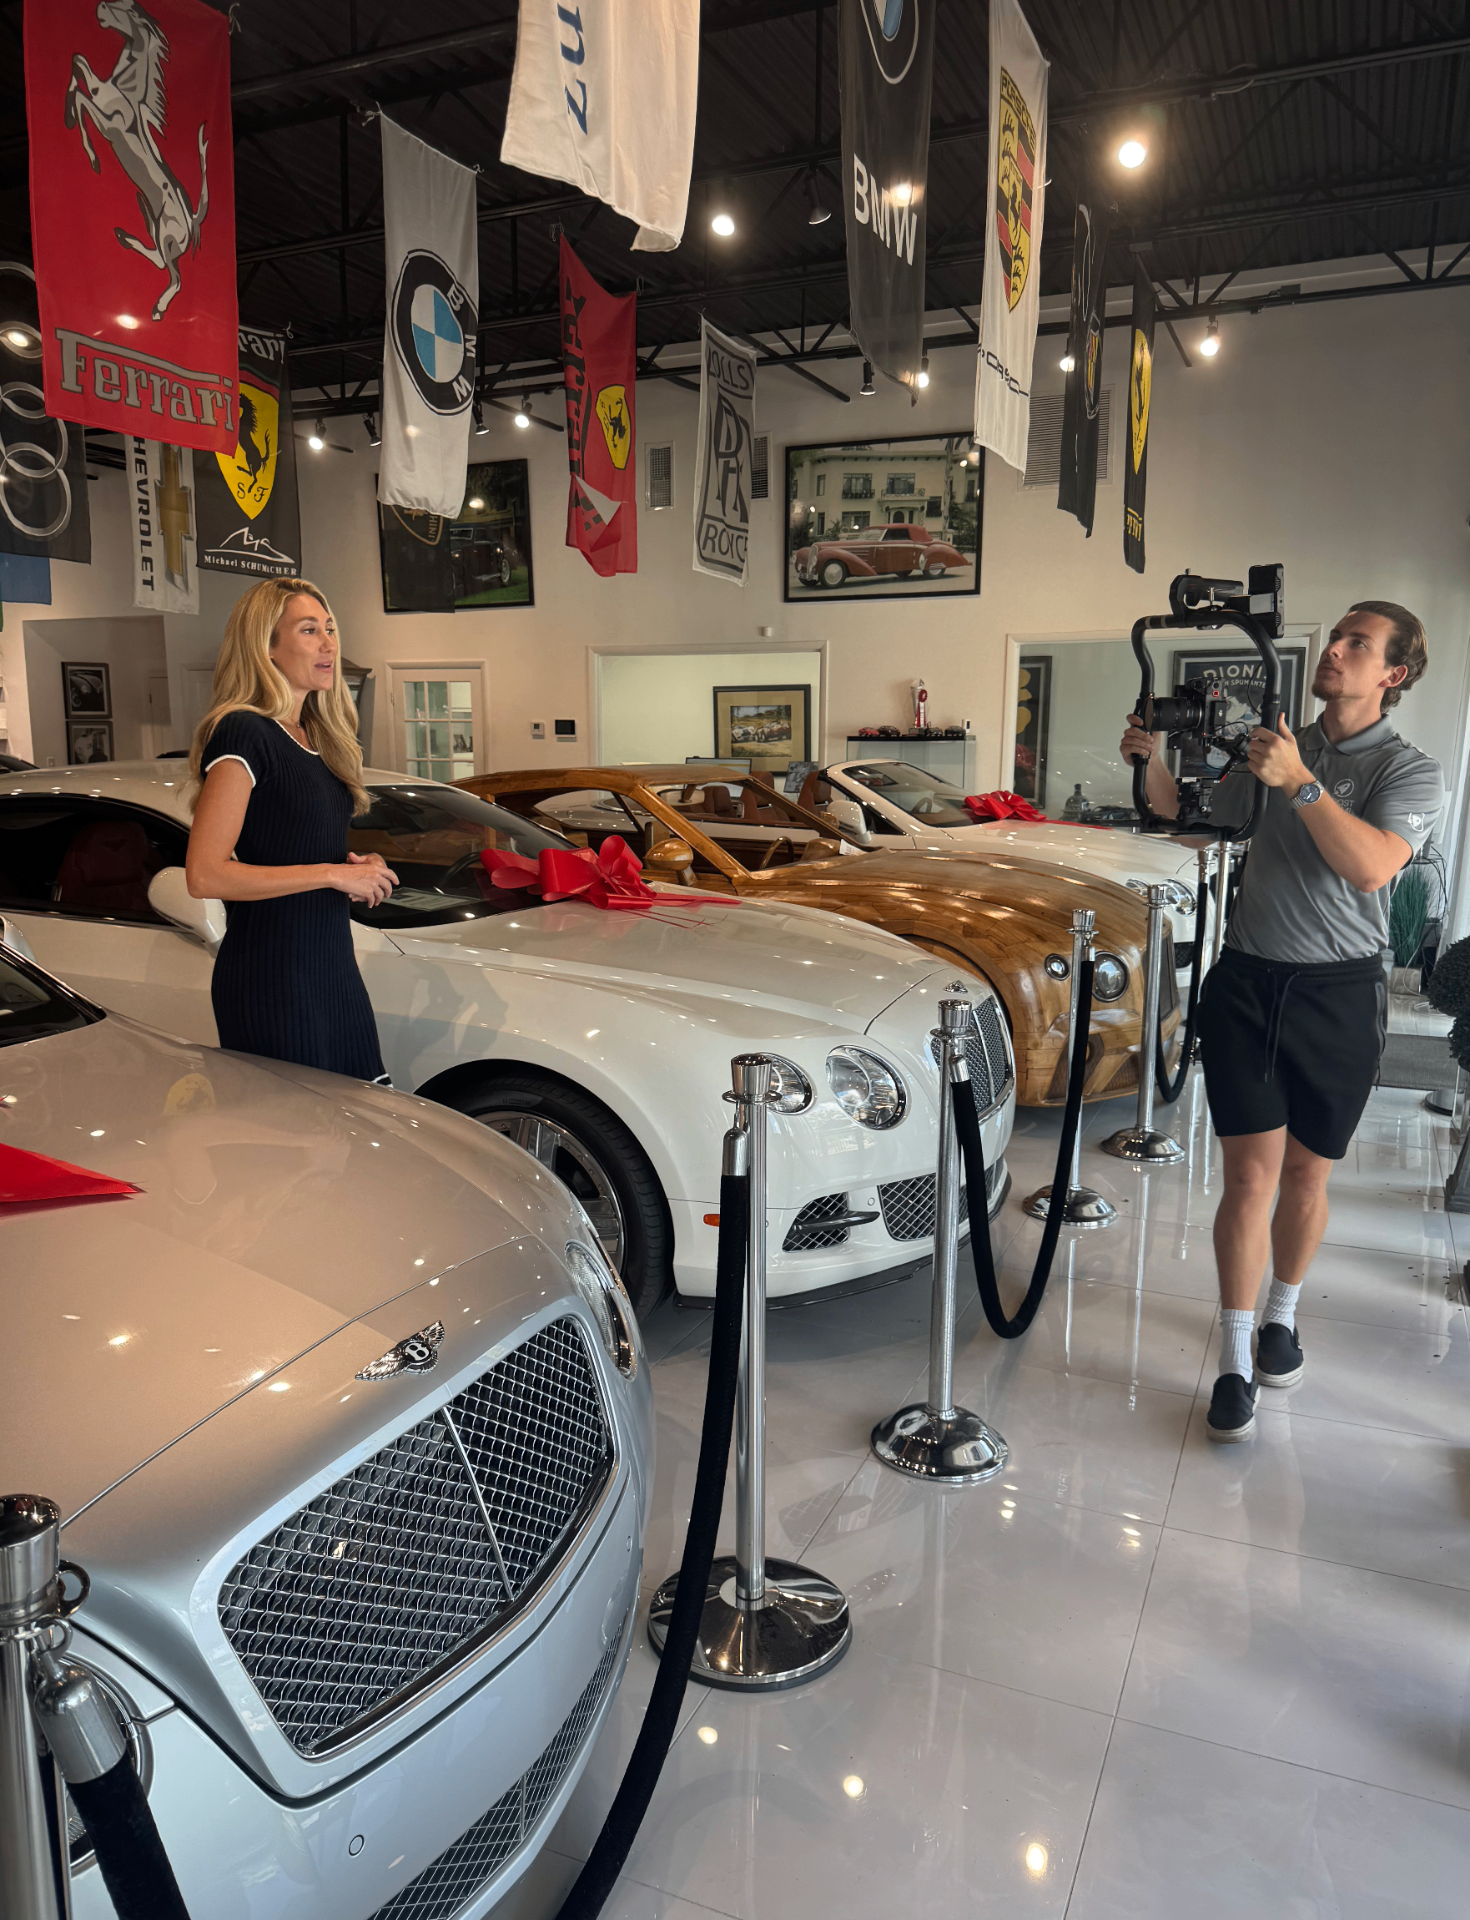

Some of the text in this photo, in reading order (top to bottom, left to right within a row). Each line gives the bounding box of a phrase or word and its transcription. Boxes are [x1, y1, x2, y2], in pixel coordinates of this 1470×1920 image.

[557, 2, 588, 136] nz
[854, 153, 918, 266] BMW
[54, 327, 235, 432] Ferrari
[238, 325, 286, 365] rari
[447, 284, 477, 403] BMW
[133, 435, 154, 591] HEVROLET
[428, 515, 438, 539] HINI
[204, 555, 238, 567] Michael
[1203, 664, 1266, 679] DIONI
[404, 1341, 431, 1362] B
